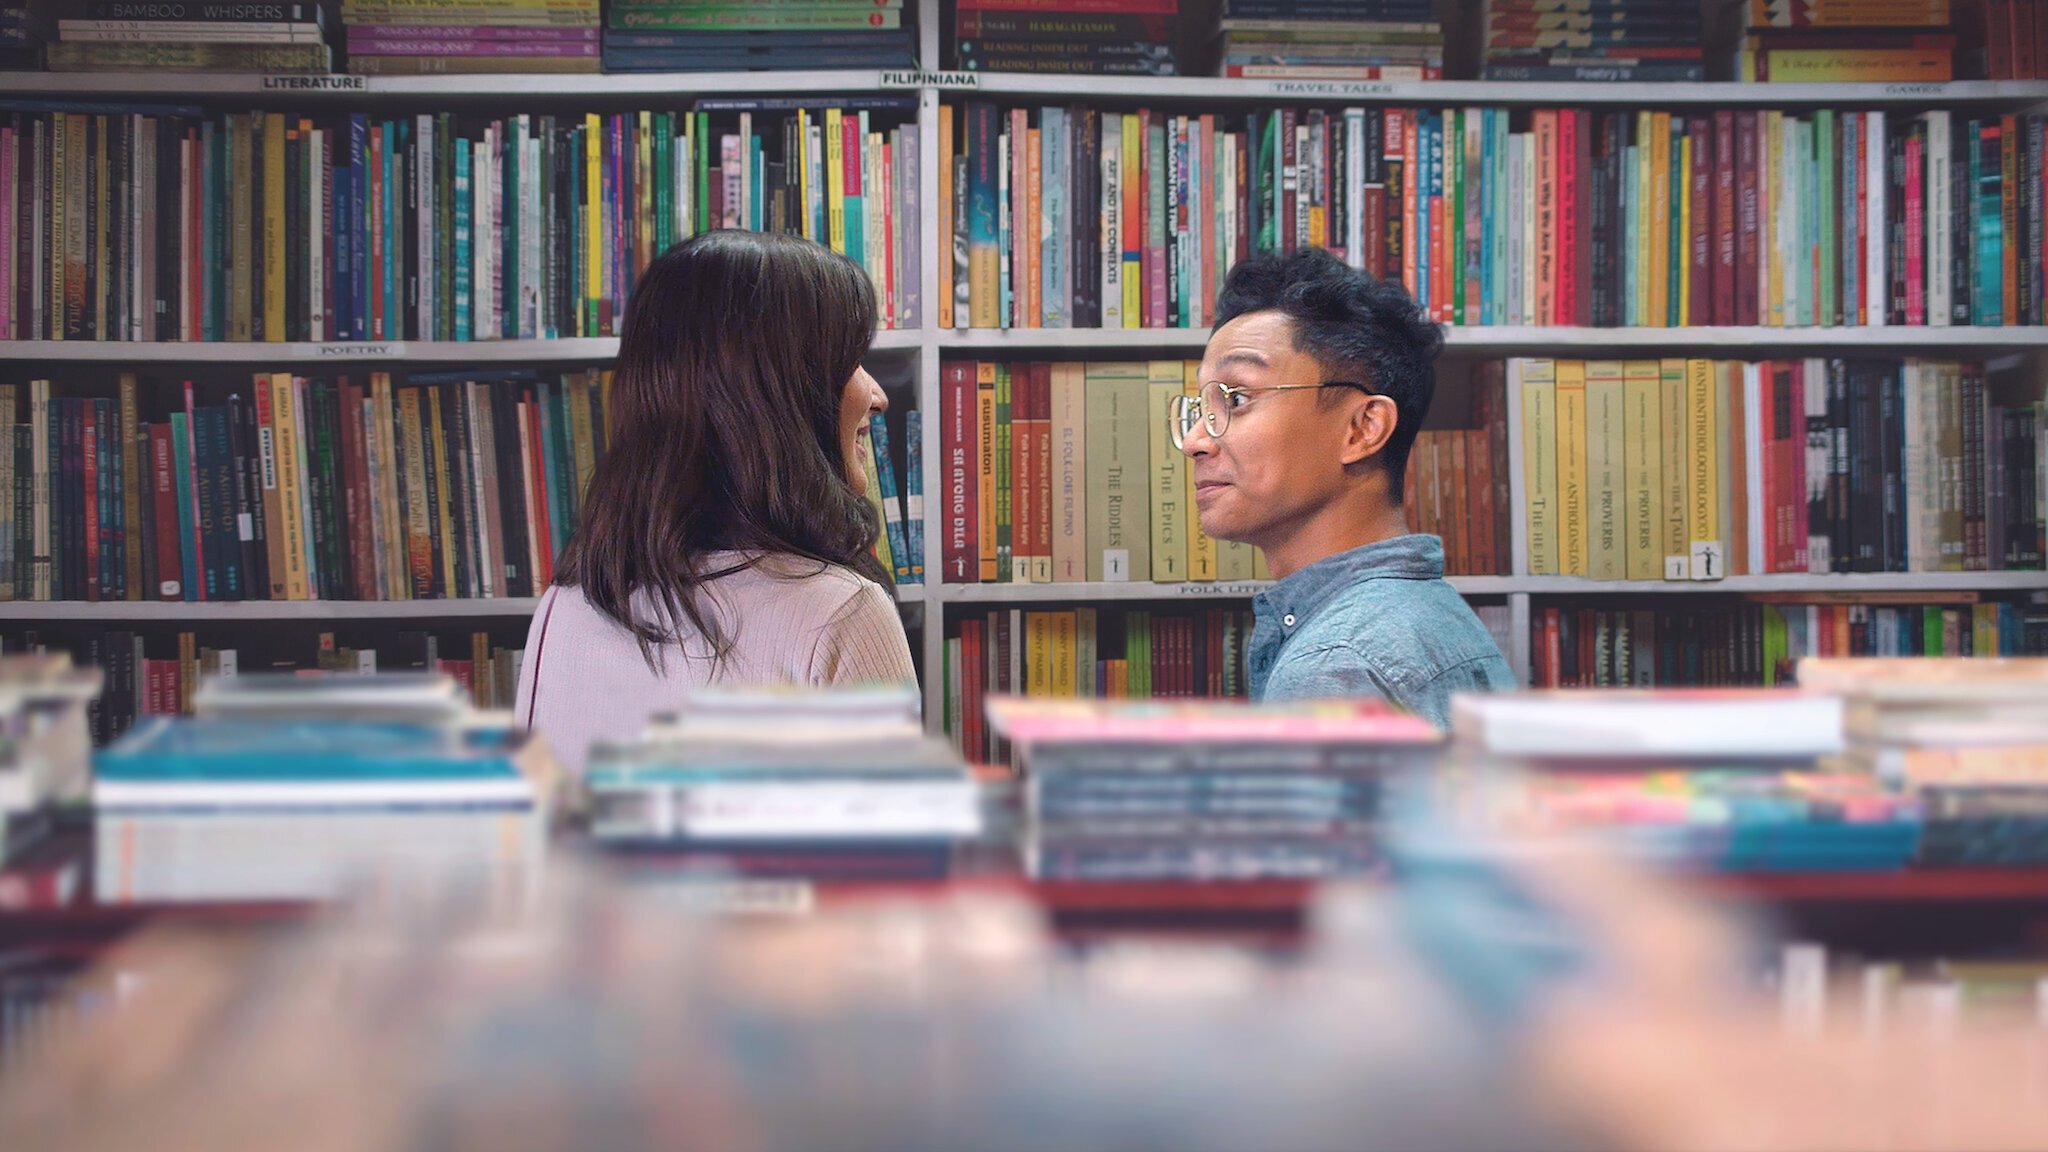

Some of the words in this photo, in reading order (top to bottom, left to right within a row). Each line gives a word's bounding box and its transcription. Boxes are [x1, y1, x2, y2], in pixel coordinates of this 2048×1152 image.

[113, 3, 186, 18] BAMBOO
[203, 4, 284, 19] WHISPERS
[1067, 42, 1089, 52] OUT
[883, 73, 977, 86] FILIPINIANA
[1073, 60, 1094, 70] OUT
[262, 77, 364, 89] LITERATURE
[1274, 83, 1337, 94] TRAVEL
[1342, 83, 1393, 94] TALES
[54, 119, 63, 150] EDWIN
[1107, 159, 1117, 179] ART
[54, 162, 63, 217] CORDEVILLA
[1107, 183, 1117, 207] AND
[1168, 186, 1178, 205] NG
[1539, 182, 1551, 206] Why
[1107, 209, 1117, 225] ITS
[1168, 205, 1178, 237] TRIP
[1541, 211, 1551, 228] We
[54, 223, 63, 261] PHOENIX
[69, 217, 81, 257] EDWIN
[1541, 232, 1550, 252] Are
[1107, 227, 1117, 285] CONTEXTS
[1541, 255, 1551, 282] Poor
[54, 271, 63, 301] OTHER
[54, 303, 63, 333] POEMS
[321, 345, 389, 355] POETRY
[982, 397, 993, 476] susumaton
[1063, 427, 1073, 438] EL
[953, 448, 965, 467] SA
[953, 468, 965, 513] AYONG
[1108, 465, 1123, 490] THE
[1161, 463, 1175, 494] THE
[1063, 497, 1074, 537] FILIPINO
[1108, 495, 1123, 547] RIDDLES
[1161, 502, 1175, 545] EPICS
[1601, 490, 1613, 551] PROVERBS
[1639, 489, 1650, 550] PROVERBS
[953, 517, 965, 549] DILA
[1670, 518, 1684, 555] TALES
[1180, 586, 1222, 595] FOLK
[1035, 618, 1043, 651] MANNY
[1060, 618, 1068, 651] MANNY
